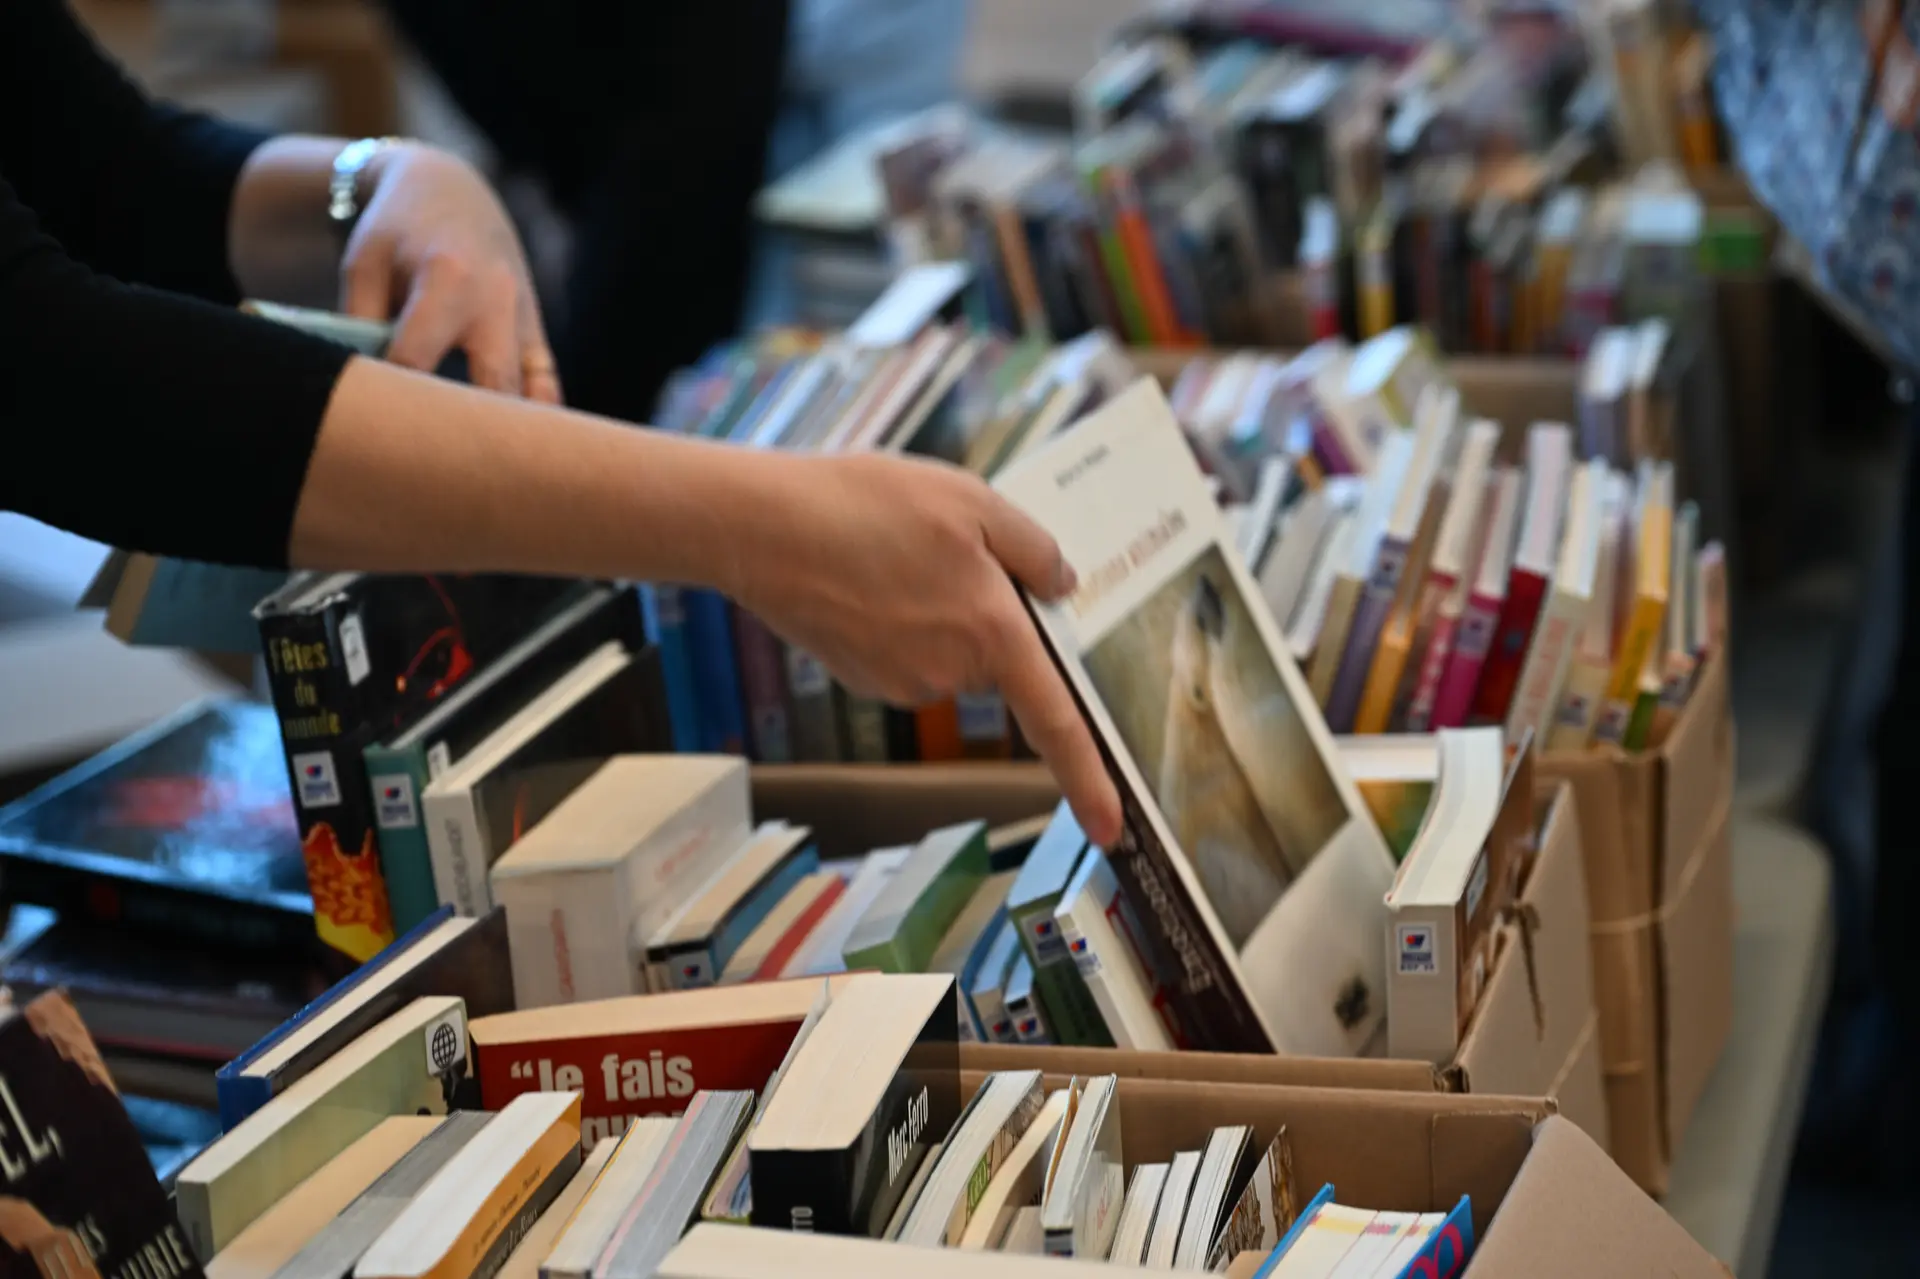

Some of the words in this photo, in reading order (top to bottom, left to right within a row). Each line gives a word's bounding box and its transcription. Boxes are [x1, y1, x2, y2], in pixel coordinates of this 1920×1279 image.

[270, 636, 328, 674] Fêtes
[295, 679, 318, 707] du
[600, 1050, 695, 1102] fais
[887, 1120, 908, 1188] Marc
[908, 1085, 929, 1151] Ferro
